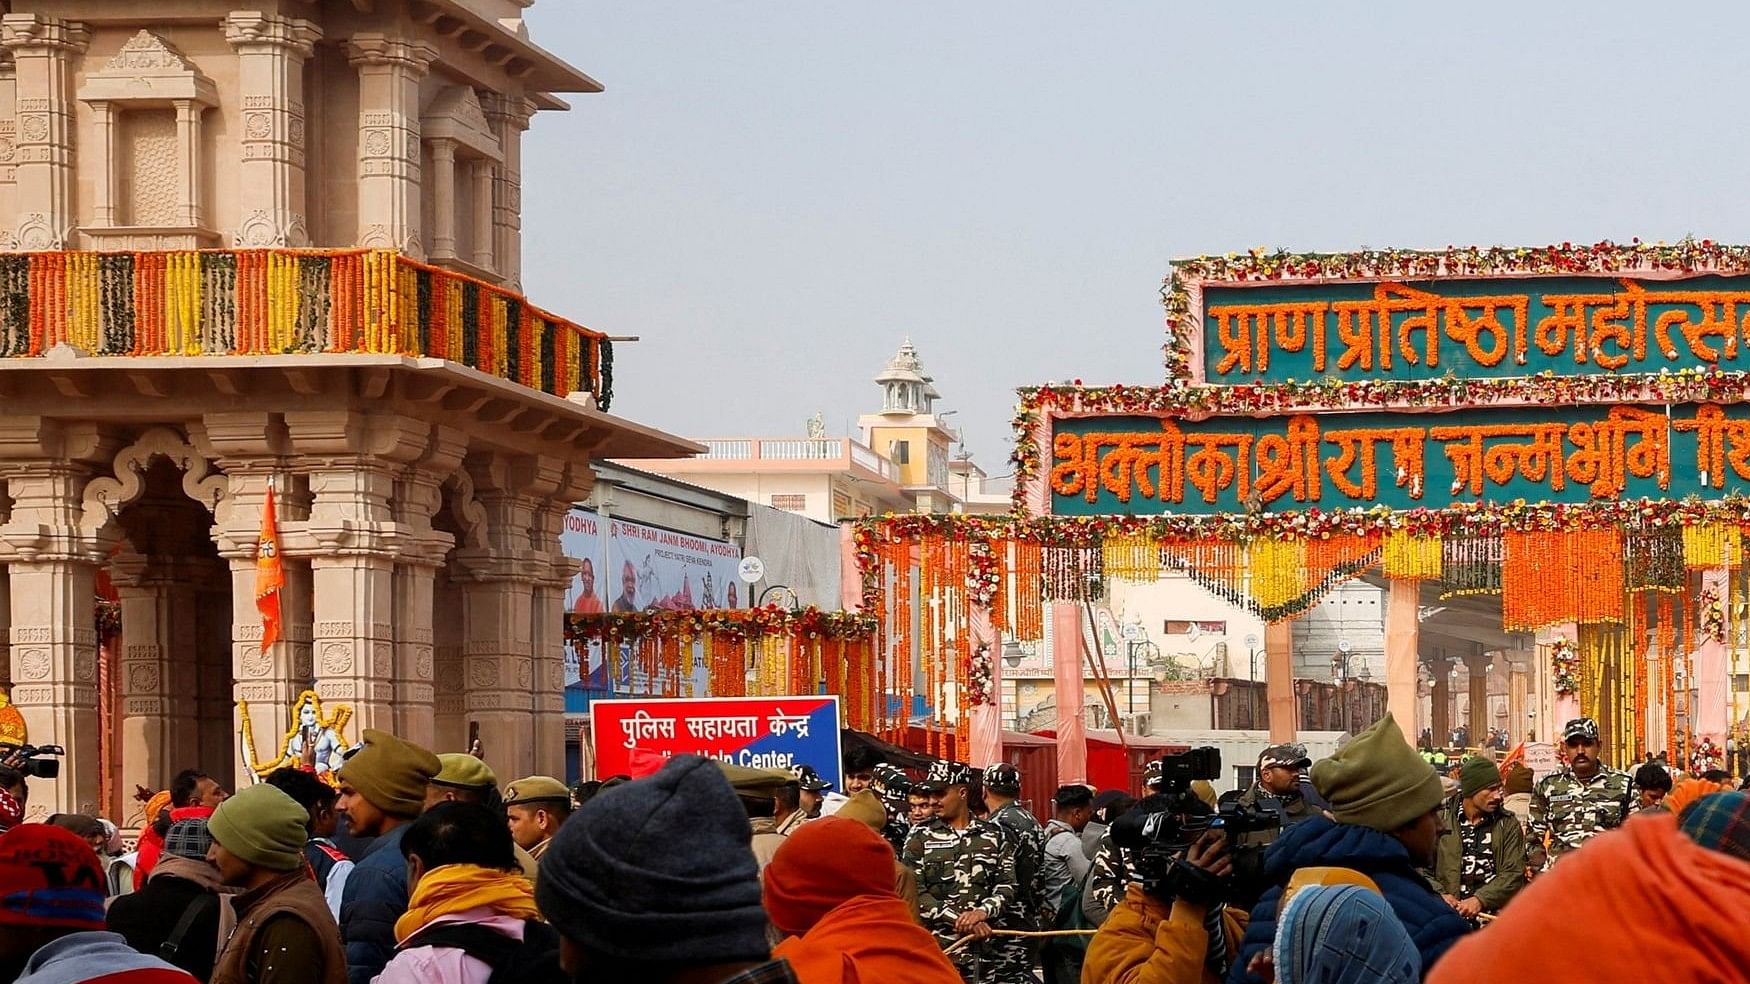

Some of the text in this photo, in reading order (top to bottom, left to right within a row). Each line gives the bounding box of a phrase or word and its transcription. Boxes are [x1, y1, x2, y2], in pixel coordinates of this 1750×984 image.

[1208, 301, 1329, 375] प्राण
[1331, 281, 1529, 371] प्रतिष्ठा
[1253, 414, 1321, 503] श्री
[563, 517, 599, 537] YODHYA
[621, 523, 640, 538] SHRI
[641, 527, 657, 543] RAM
[659, 532, 679, 547] JANM
[710, 544, 740, 559] AYODHYA
[619, 707, 812, 749] पुलिस सहायता केन्द्र
[739, 748, 794, 769] Center
